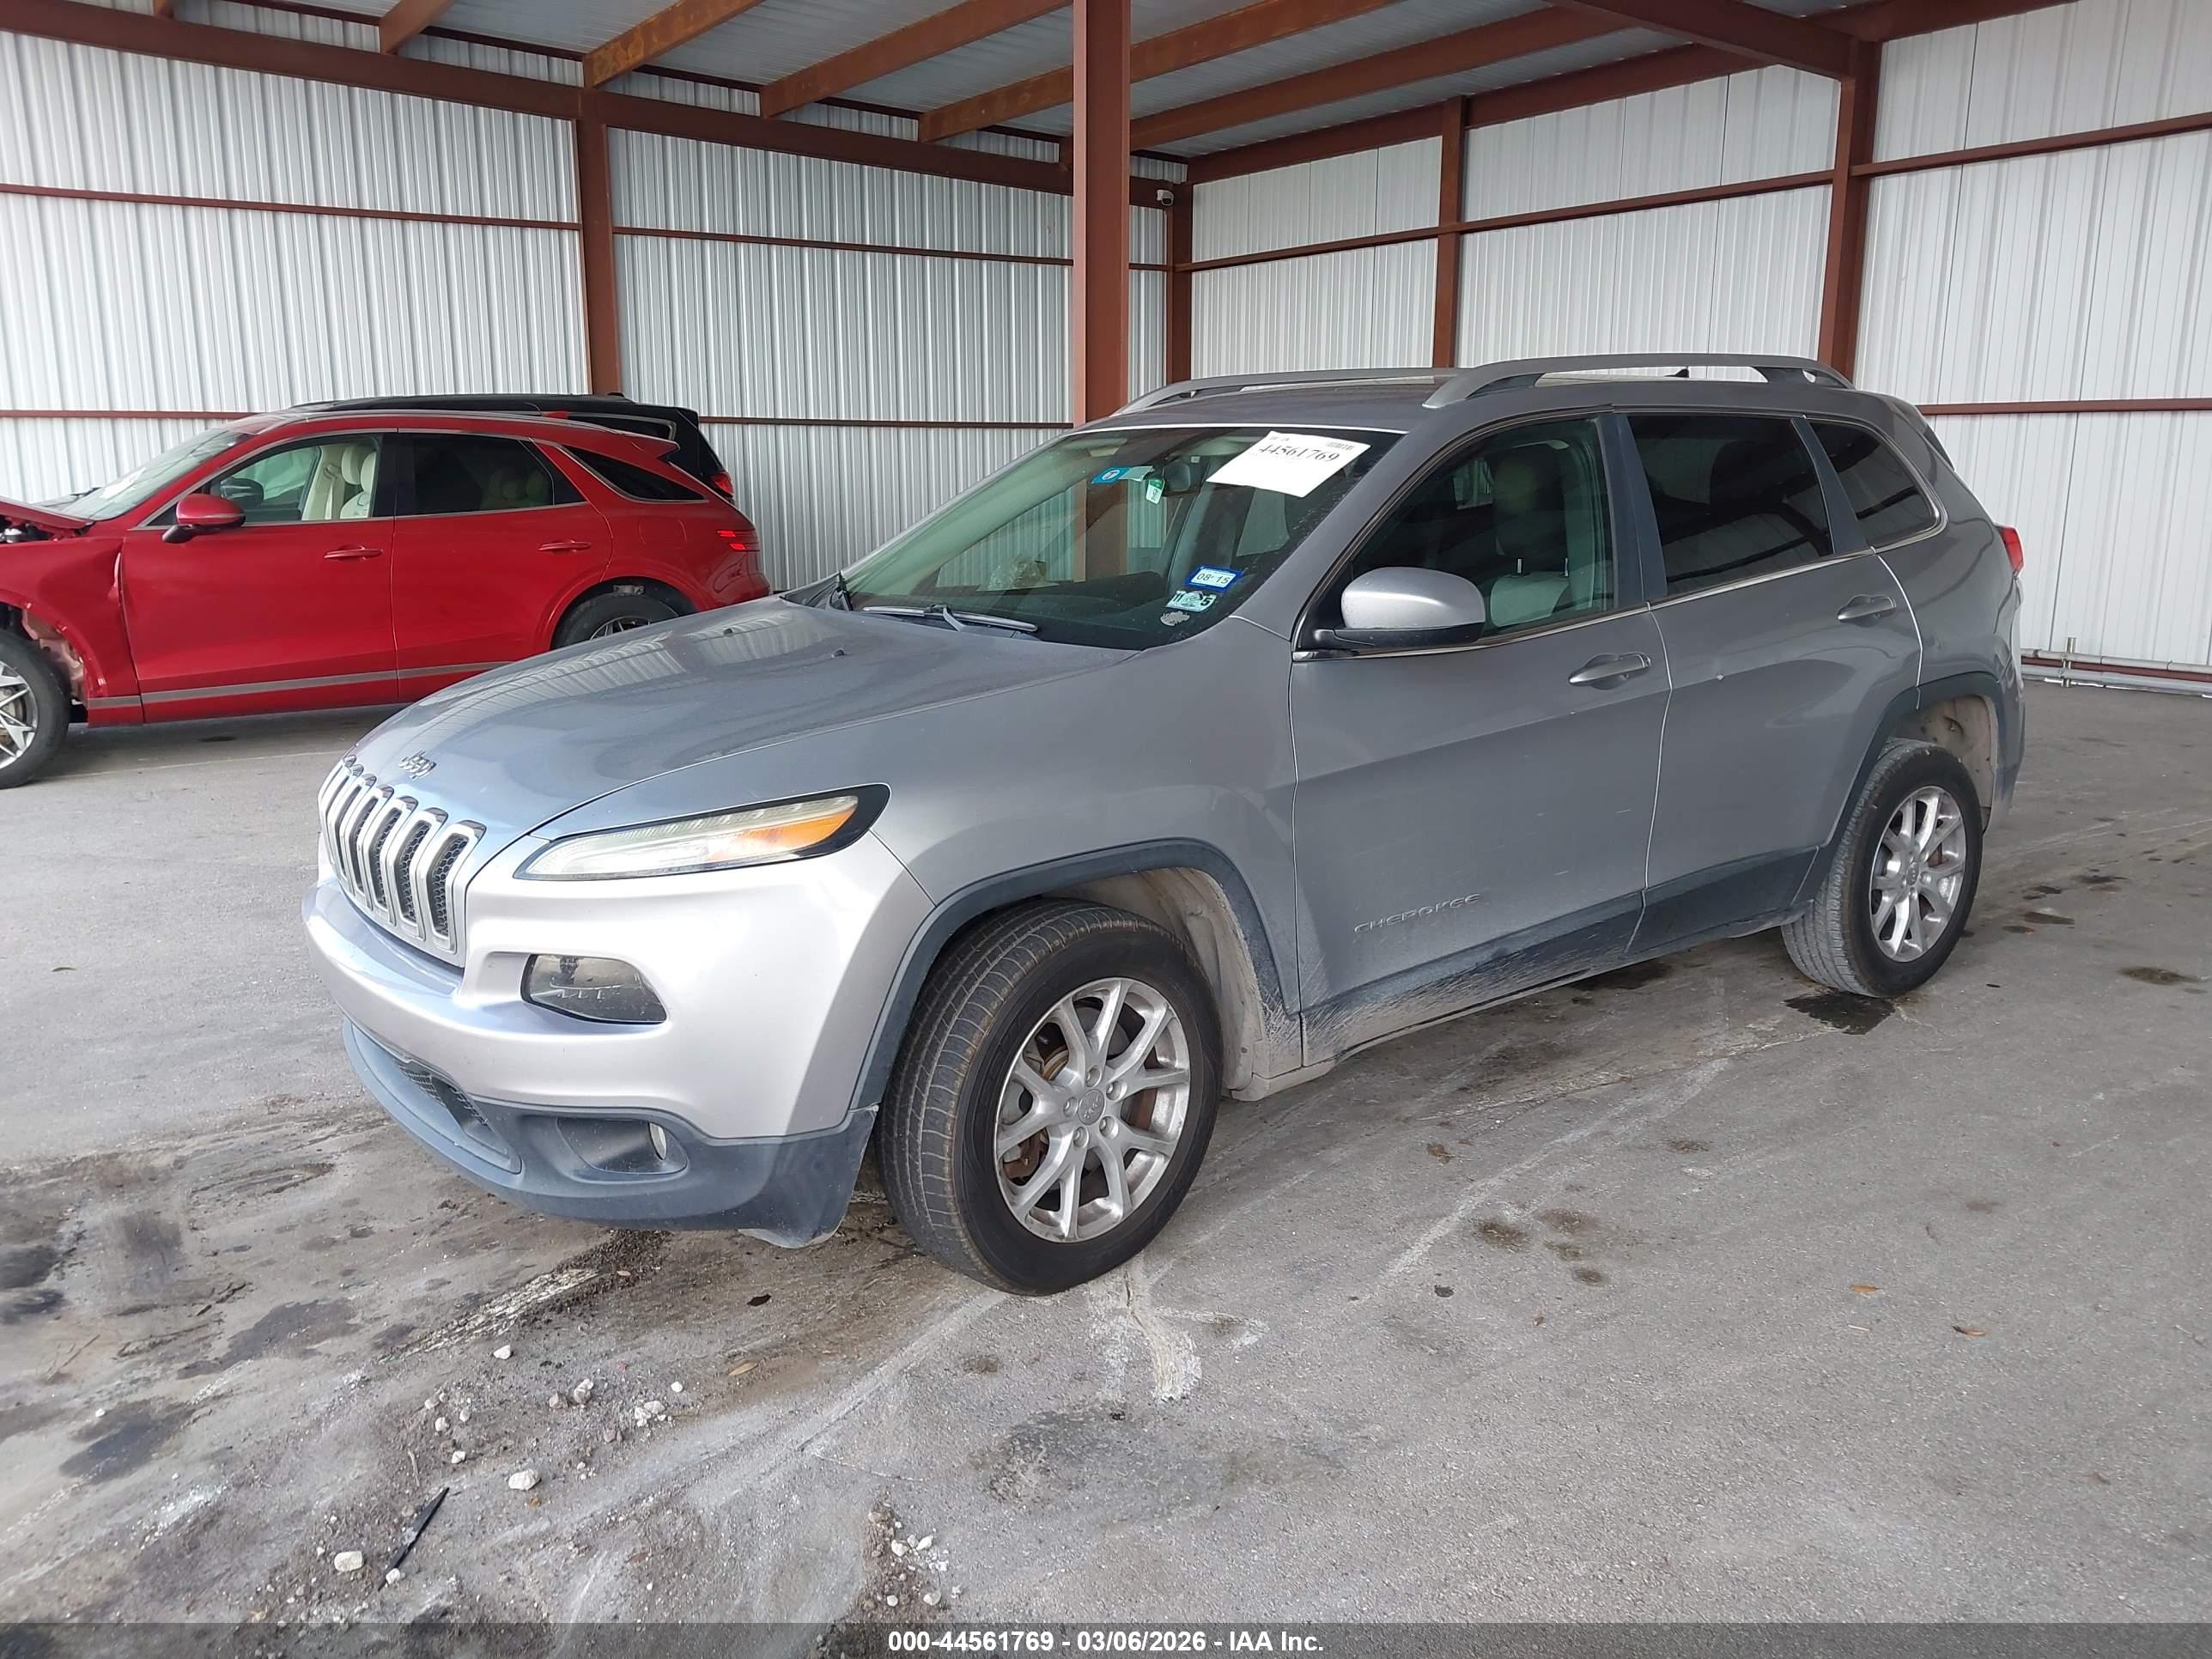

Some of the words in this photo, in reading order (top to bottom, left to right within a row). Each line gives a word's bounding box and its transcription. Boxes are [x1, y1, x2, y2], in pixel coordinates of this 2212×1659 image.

[1259, 443, 1340, 462] 44561769
[398, 749, 437, 780] Jeep
[1353, 892, 1482, 934] CHEROKEE
